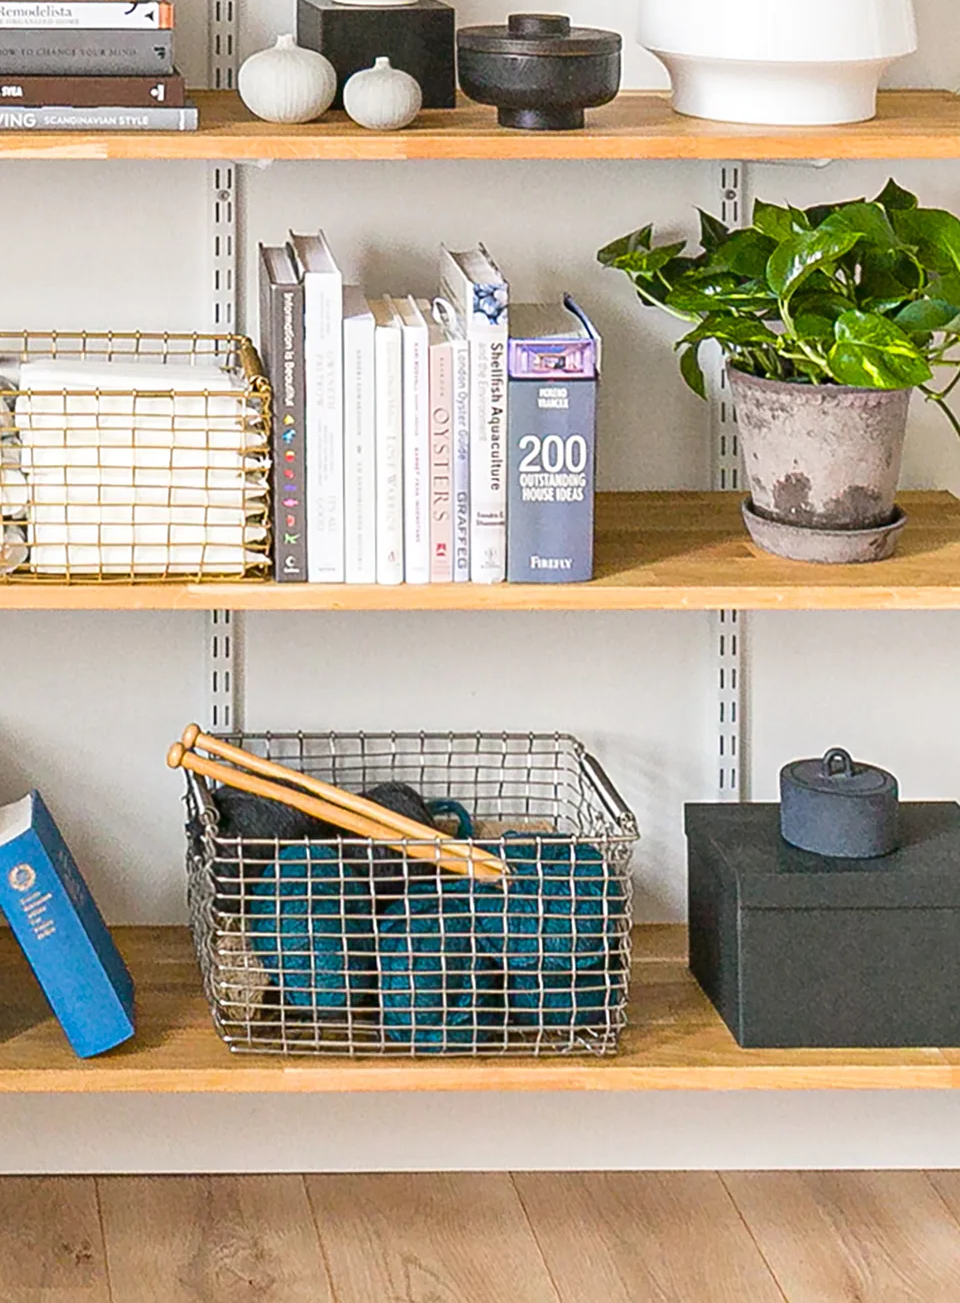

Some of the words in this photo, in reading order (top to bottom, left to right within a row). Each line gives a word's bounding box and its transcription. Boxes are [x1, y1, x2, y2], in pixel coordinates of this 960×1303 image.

[21, 48, 34, 57] TO
[35, 48, 77, 57] CHANGE
[80, 48, 106, 57] YOUR
[109, 48, 137, 57] MIND
[43, 115, 117, 125] SCANDINAVIAN
[118, 115, 149, 125] STYLE
[283, 292, 296, 350] Information
[284, 351, 295, 360] is
[458, 348, 469, 389] London
[491, 342, 505, 402] Shellfish
[284, 361, 296, 407] Beautiful
[456, 391, 469, 427] Oyster
[457, 429, 468, 461] Guide
[488, 406, 504, 491] Aquaculture
[518, 434, 587, 473] 200
[433, 407, 450, 522] OYSTERS
[519, 473, 587, 488] OUTSTANDING
[522, 487, 554, 501] HOUSE
[555, 487, 584, 501] IDEAS
[457, 491, 468, 569] GRAFFEG
[530, 555, 573, 569] FIREFLY
